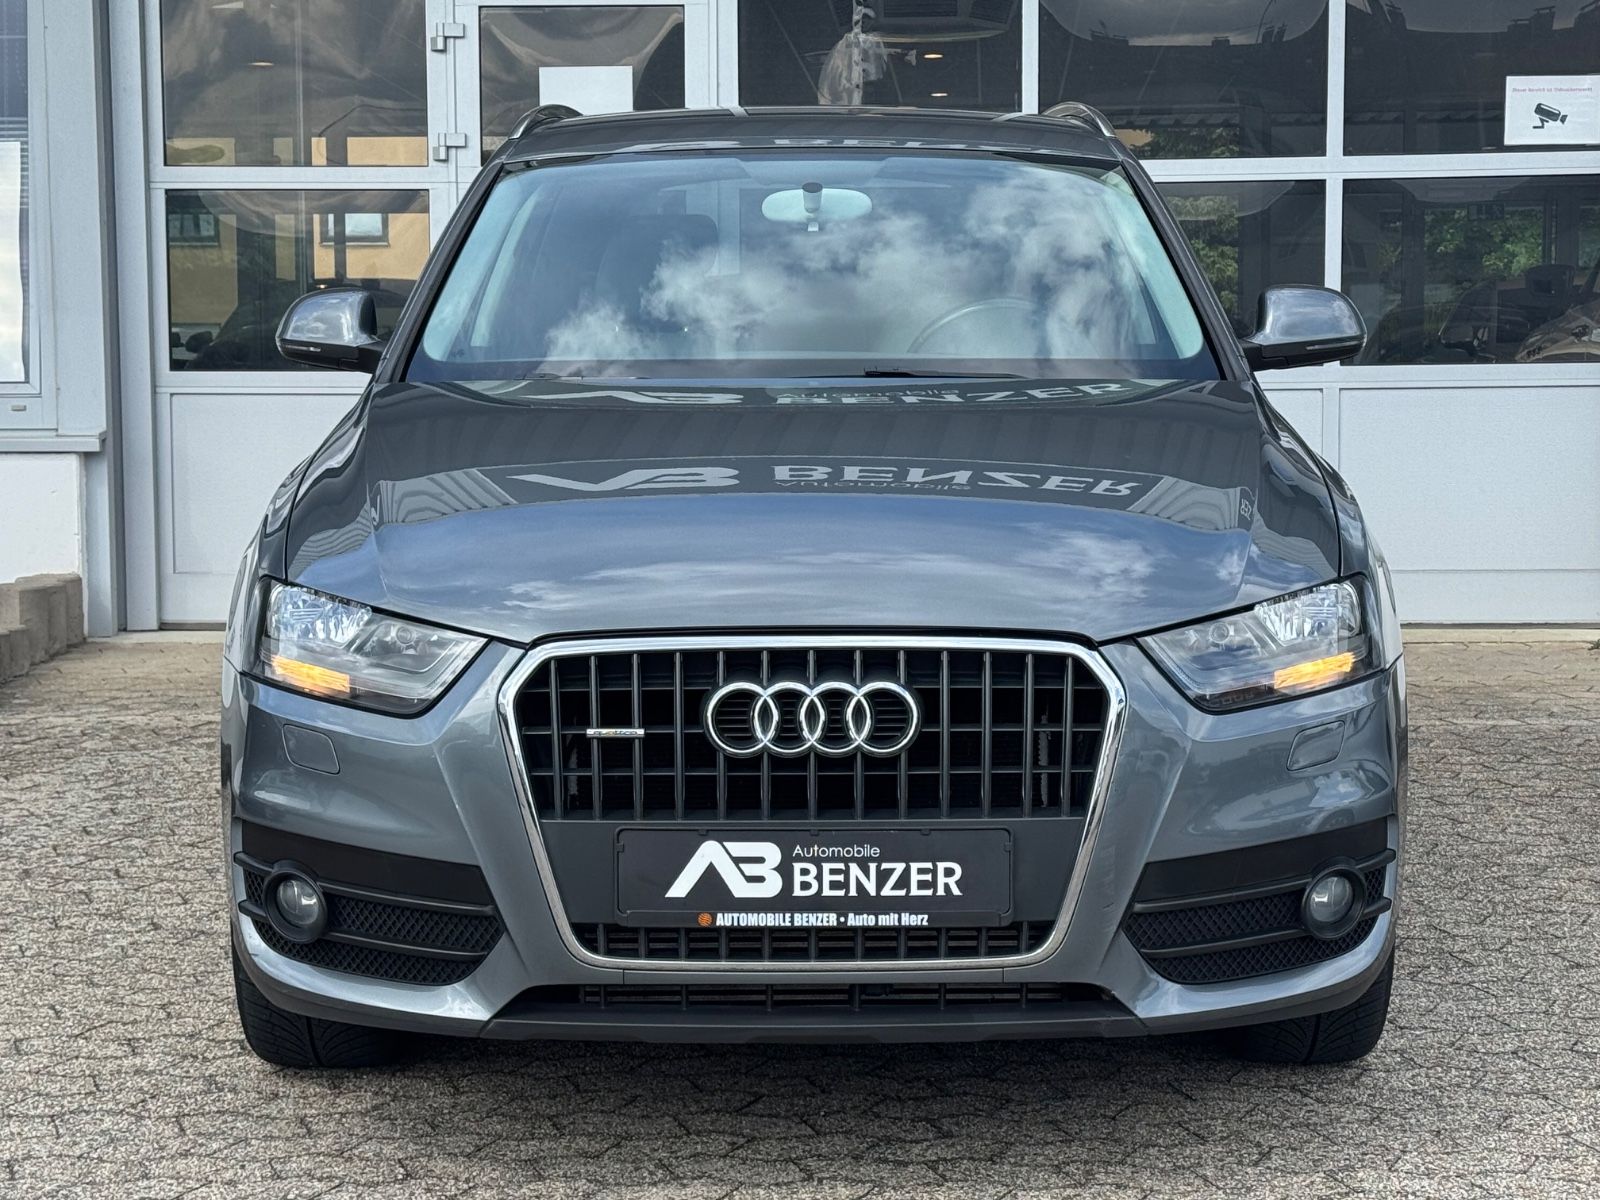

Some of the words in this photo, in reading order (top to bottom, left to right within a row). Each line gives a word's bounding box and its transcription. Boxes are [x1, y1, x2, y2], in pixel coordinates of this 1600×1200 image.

[792, 844, 880, 858] Automobile
[792, 862, 963, 897] BENZER
[716, 913, 791, 927] AUTOMOBILE
[793, 913, 837, 927] BENZER
[847, 913, 876, 927] Auto
[878, 913, 899, 927] mit
[901, 913, 929, 927] Herz
